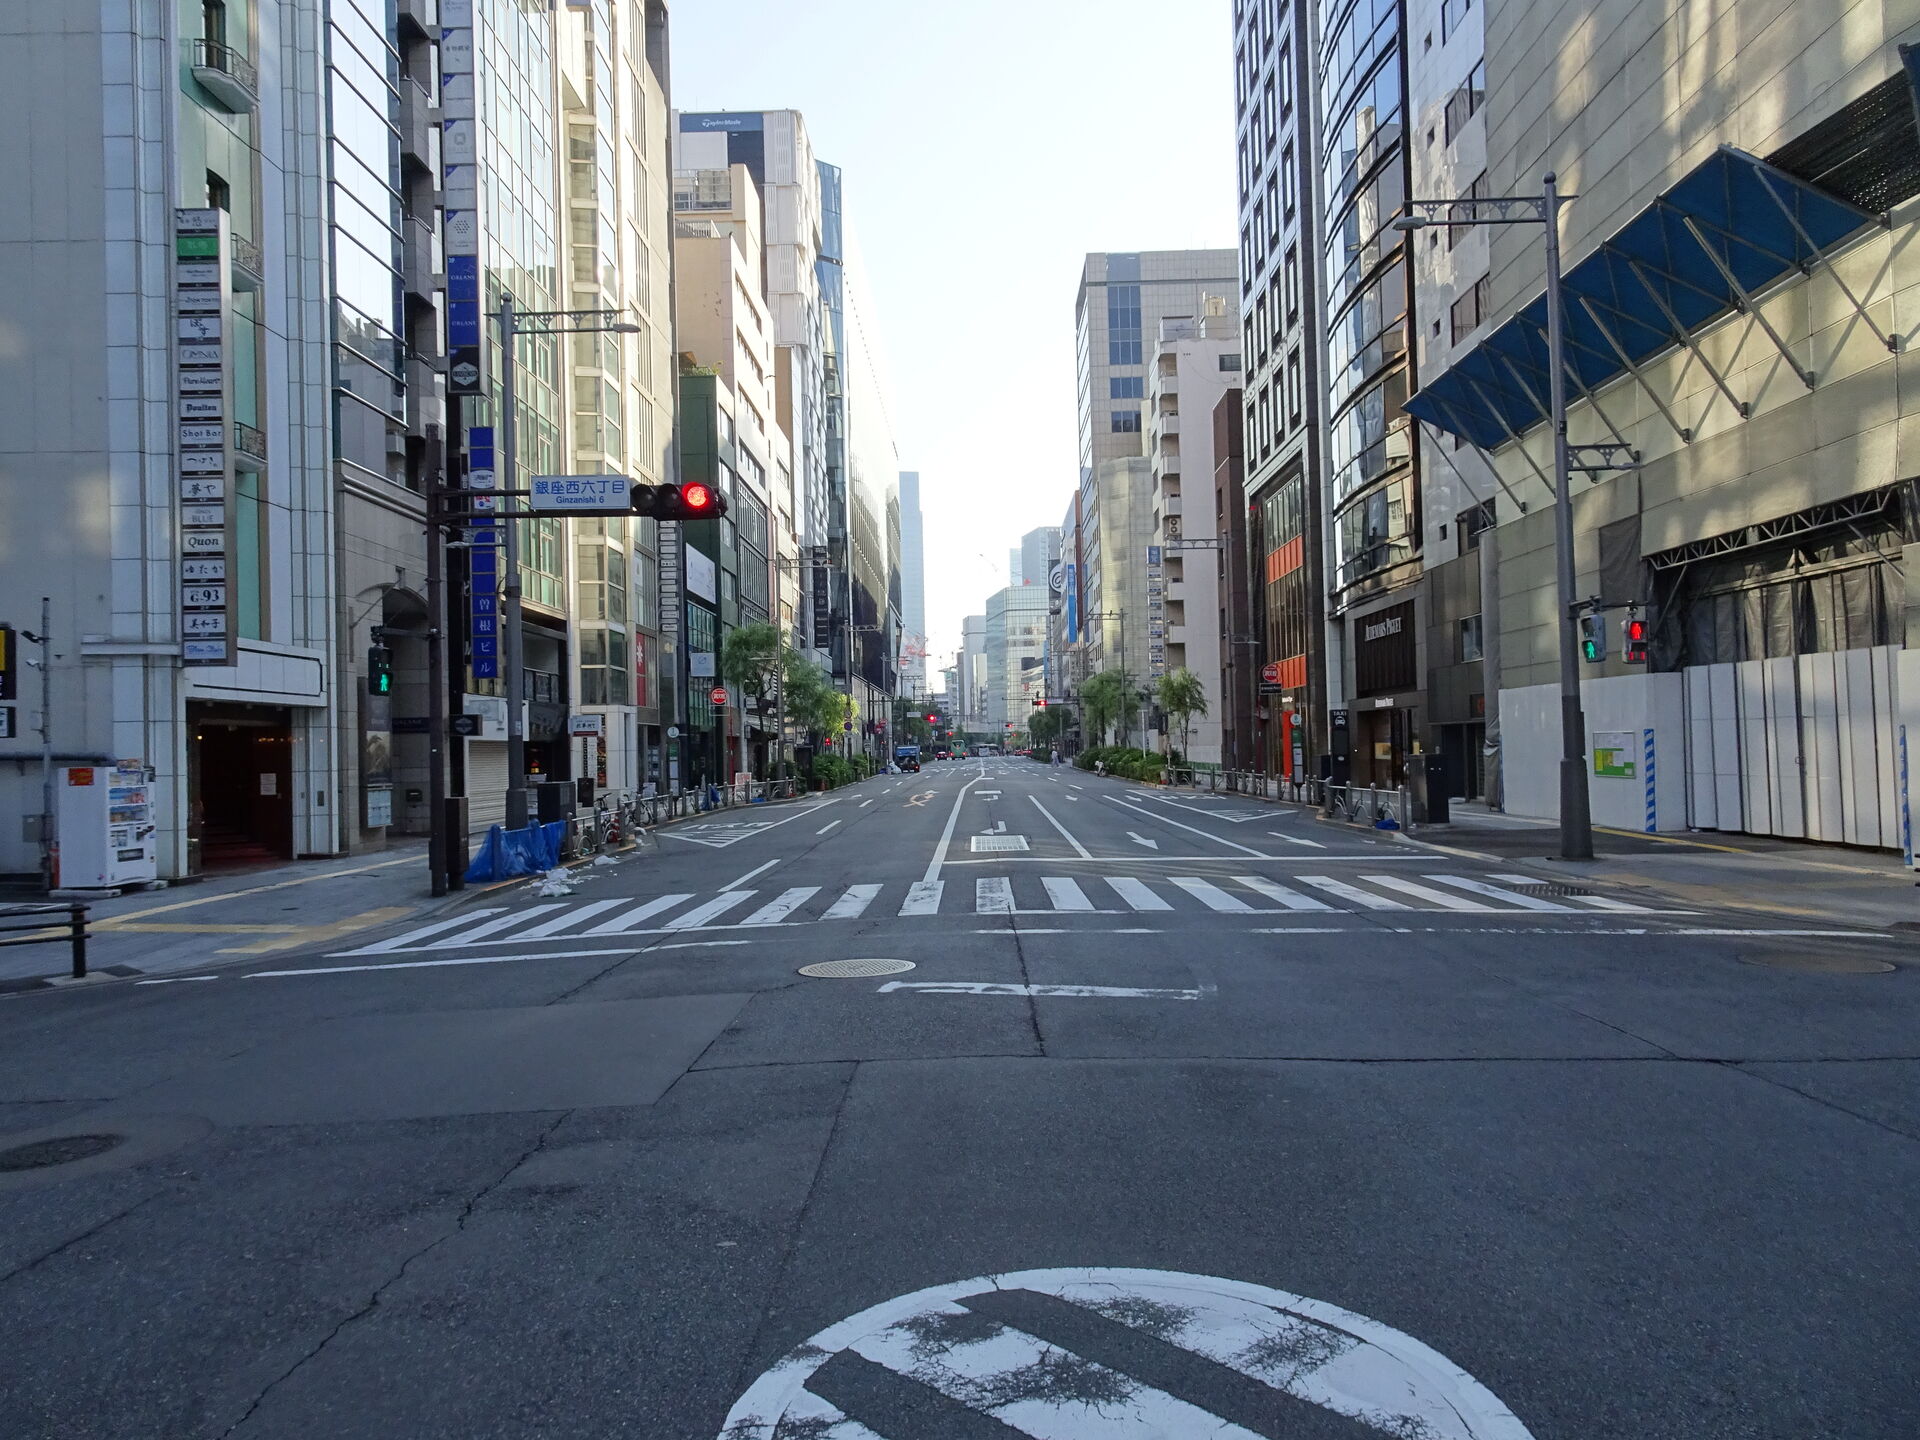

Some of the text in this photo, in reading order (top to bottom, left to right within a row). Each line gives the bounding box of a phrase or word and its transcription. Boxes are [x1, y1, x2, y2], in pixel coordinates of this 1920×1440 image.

[182, 428, 222, 437] Shot Bar
[535, 480, 625, 495] 銀座西六丁目
[555, 495, 605, 504] Ginzanishi 6
[188, 536, 219, 548] Quon
